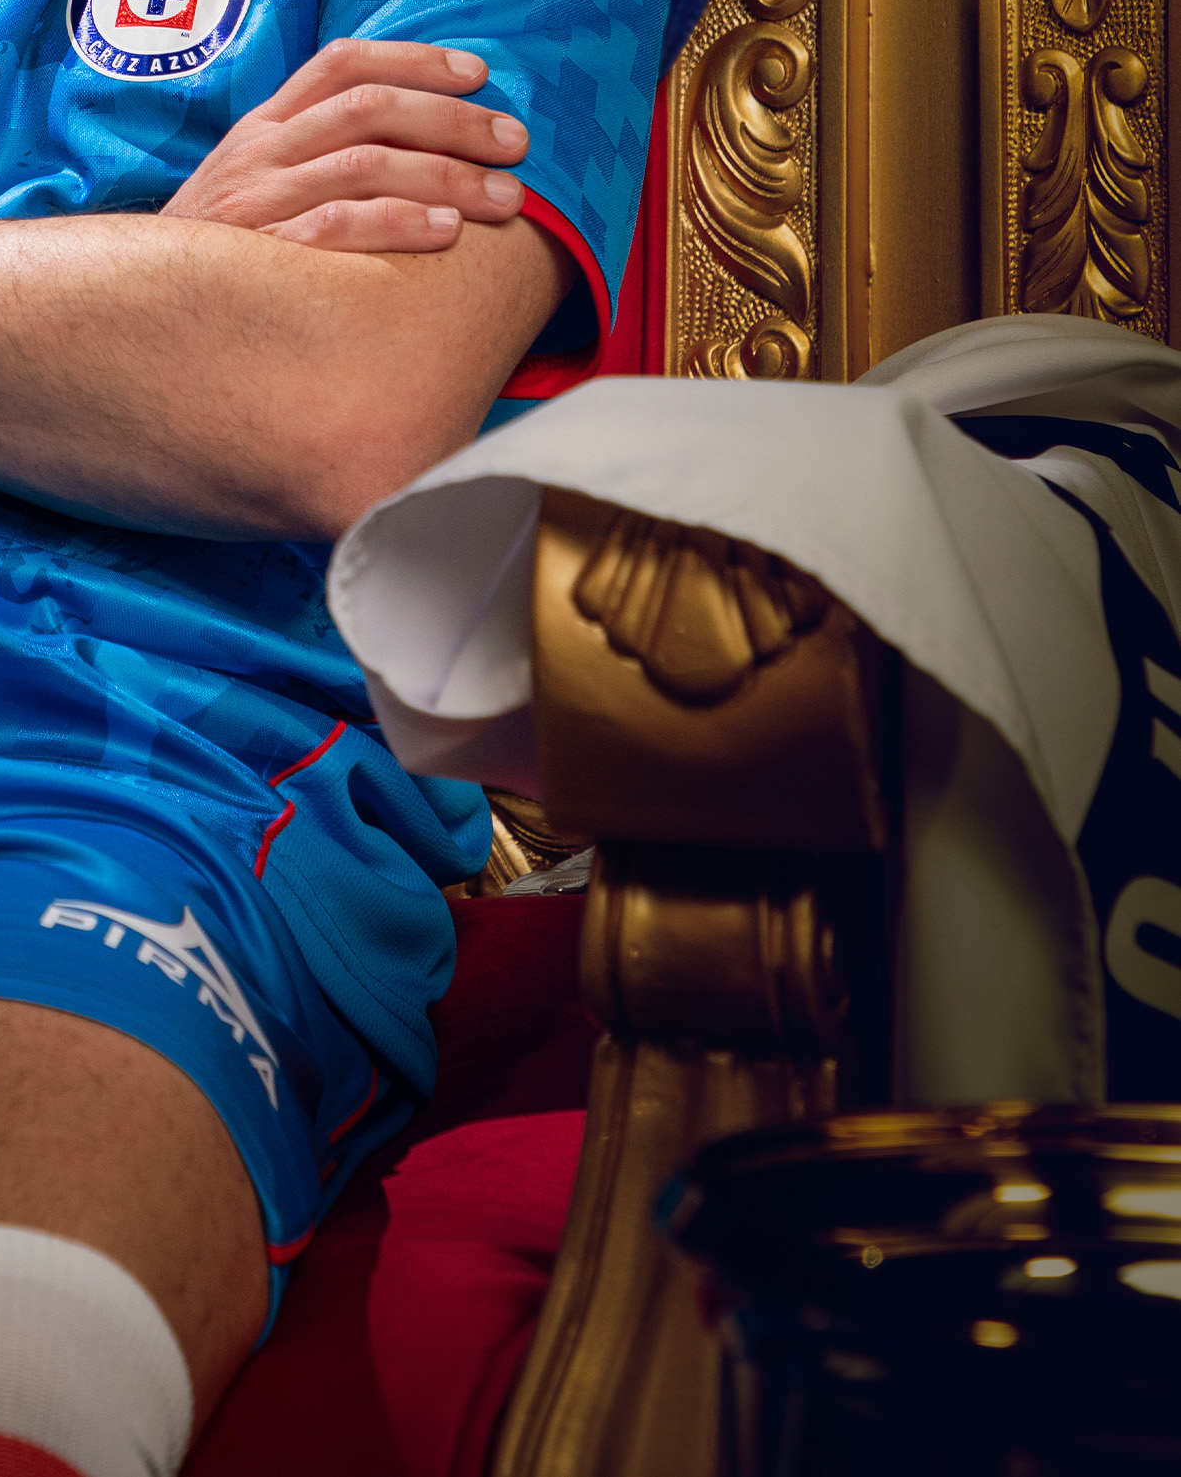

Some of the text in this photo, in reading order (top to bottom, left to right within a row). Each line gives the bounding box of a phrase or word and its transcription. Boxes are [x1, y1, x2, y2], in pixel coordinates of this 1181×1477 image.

[88, 40, 213, 72] CRUZ AZUL
[39, 903, 279, 1111] PIRMA
